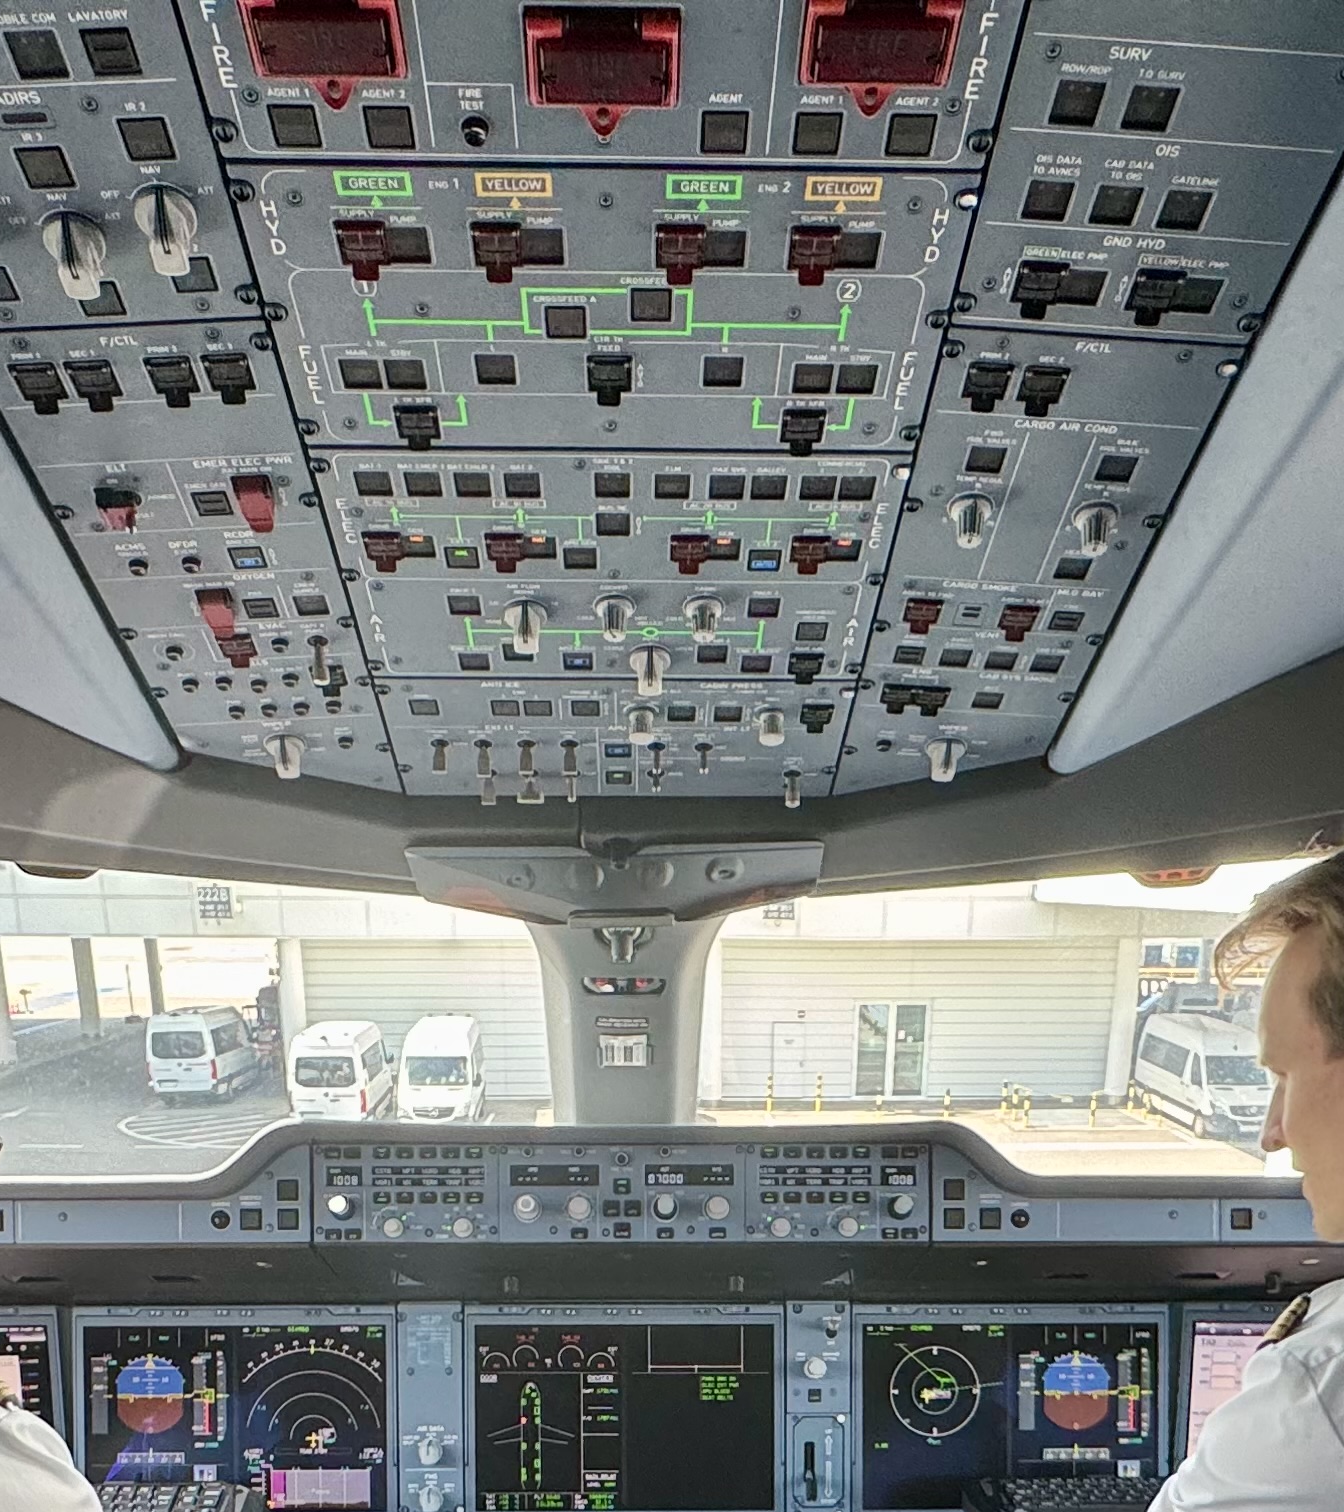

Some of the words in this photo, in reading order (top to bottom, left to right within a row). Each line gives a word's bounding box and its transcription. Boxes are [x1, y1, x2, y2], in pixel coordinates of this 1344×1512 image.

[32, 12, 57, 24] COM
[67, 9, 129, 23] LAVATORY
[964, 12, 999, 100] FIRE
[1109, 46, 1152, 62] SURV
[267, 86, 301, 98] AGENT
[362, 88, 394, 99] AGENT
[458, 88, 482, 99] FIRE
[709, 93, 743, 104] AGENT
[459, 100, 484, 111] TEST
[800, 94, 834, 105] AGENT
[896, 95, 927, 107] AGENT
[1155, 143, 1180, 158] OIS
[1056, 155, 1082, 166] DATA
[348, 176, 399, 191] GREEN
[428, 179, 449, 190] ENG
[485, 177, 542, 191] YELLOW
[680, 181, 729, 194] GREEN
[758, 183, 779, 193] ENG
[782, 181, 791, 193] 2
[816, 181, 874, 195] YELLOW
[260, 200, 287, 256] HYD
[924, 208, 949, 263] HYD
[1103, 235, 1132, 249] GND
[1136, 236, 1166, 251] HYD
[100, 336, 138, 347] F/CTL
[1075, 342, 1111, 354] F/CTL
[297, 346, 325, 405] FUEL
[893, 352, 918, 411] FUEL
[1014, 418, 1055, 431] CARGO
[1059, 421, 1081, 432] AIR
[1084, 423, 1118, 435] COND
[192, 459, 227, 469] EMER
[231, 457, 262, 467] ELEC
[265, 455, 292, 465] PWR
[336, 498, 358, 544] ELEC
[869, 503, 889, 550] ELEC
[232, 572, 275, 581] OXYGEN
[942, 580, 978, 590] CARGO
[981, 583, 1017, 592] SMOKE
[370, 613, 387, 644] AIR
[842, 617, 858, 647] AIR
[333, 1175, 359, 1186] 1008
[887, 1174, 914, 1185] 1008
